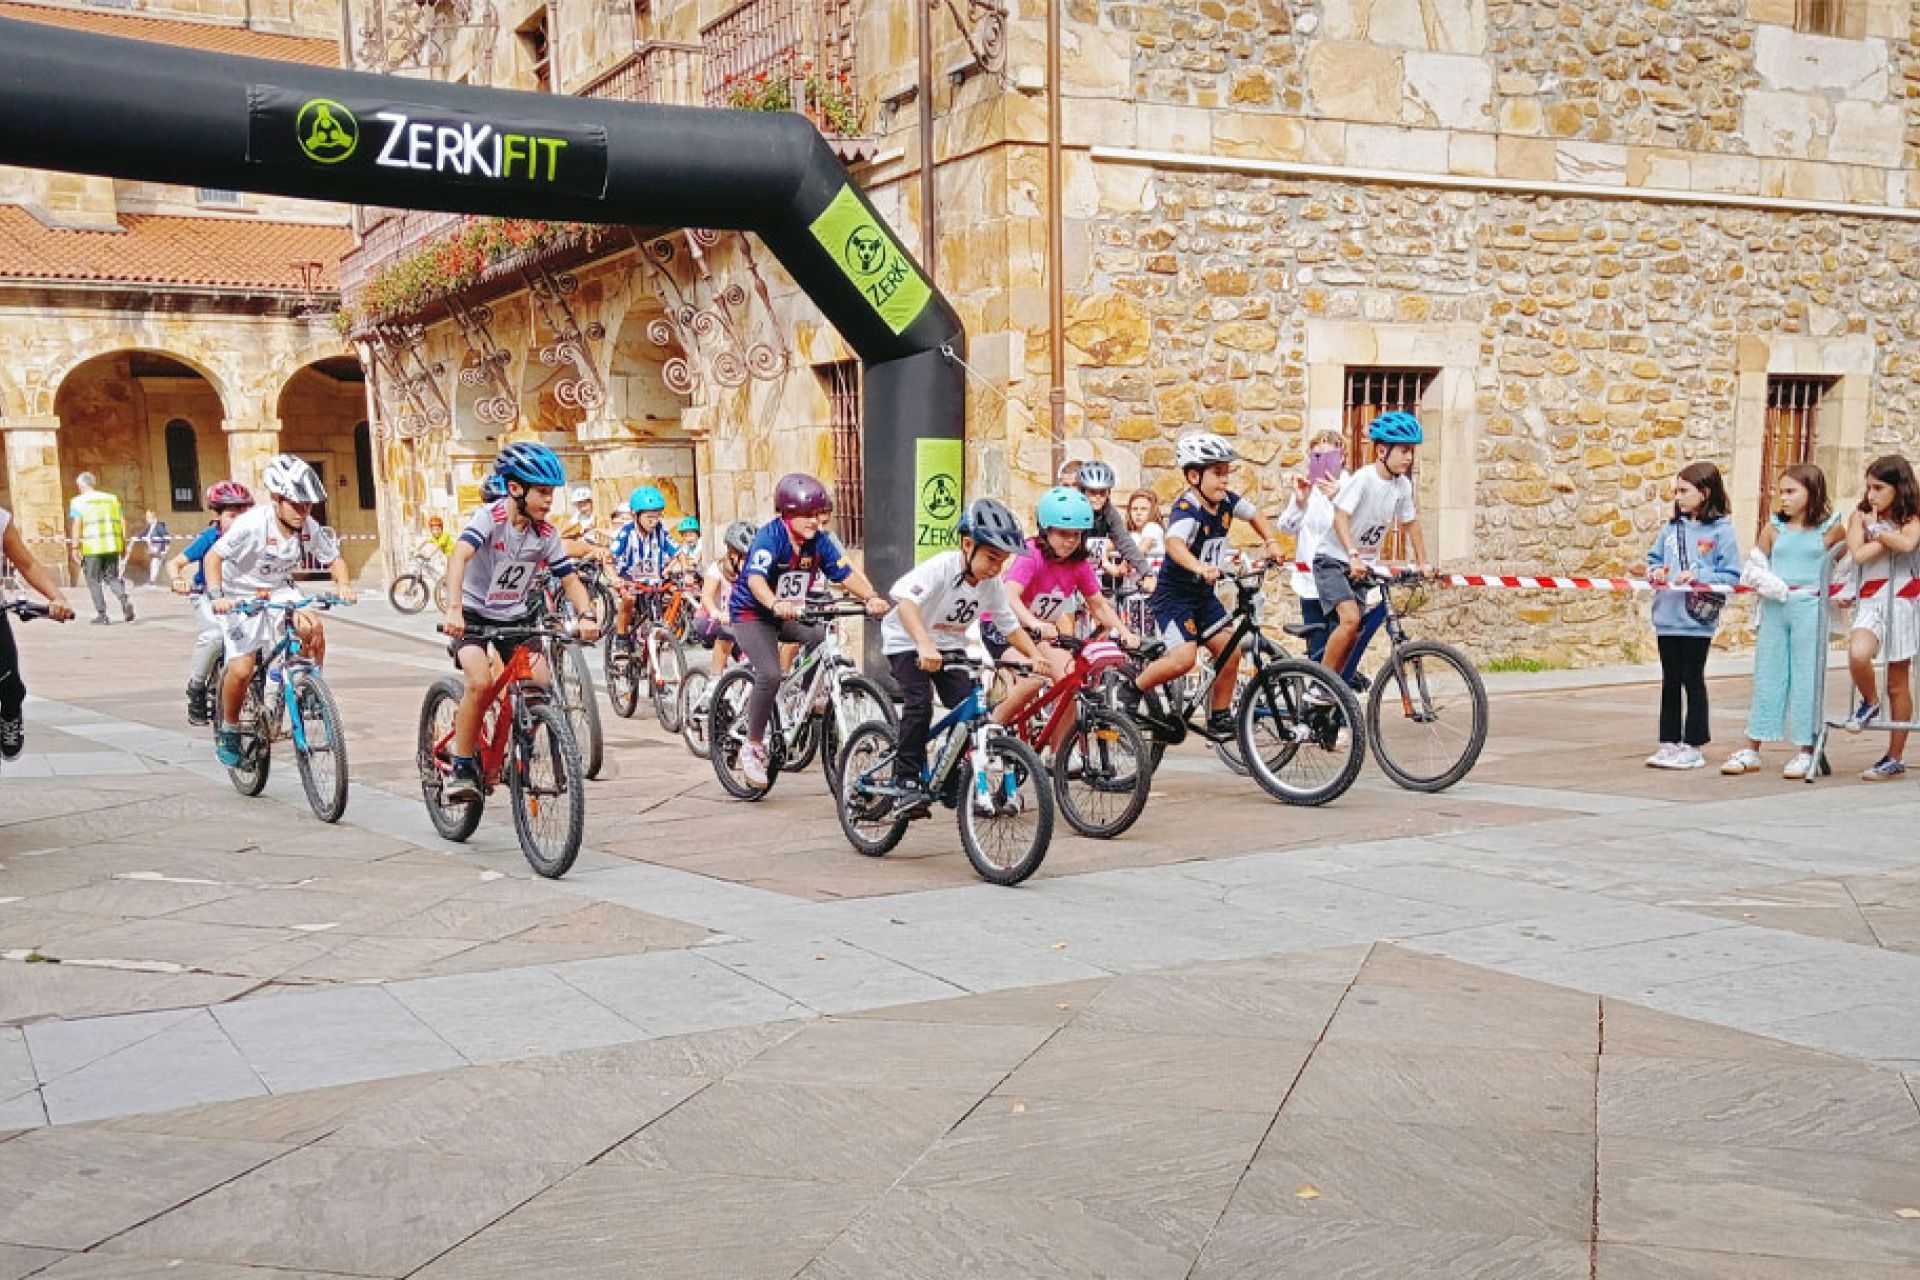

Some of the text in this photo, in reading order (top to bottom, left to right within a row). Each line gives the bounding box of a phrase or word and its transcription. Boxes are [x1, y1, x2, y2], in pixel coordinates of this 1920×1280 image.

[375, 111, 568, 182] ZERKIFIT
[1360, 525, 1385, 546] 45
[497, 565, 525, 590] 42
[780, 574, 803, 599] 35
[945, 598, 979, 624] 36
[1033, 596, 1063, 619] 37
